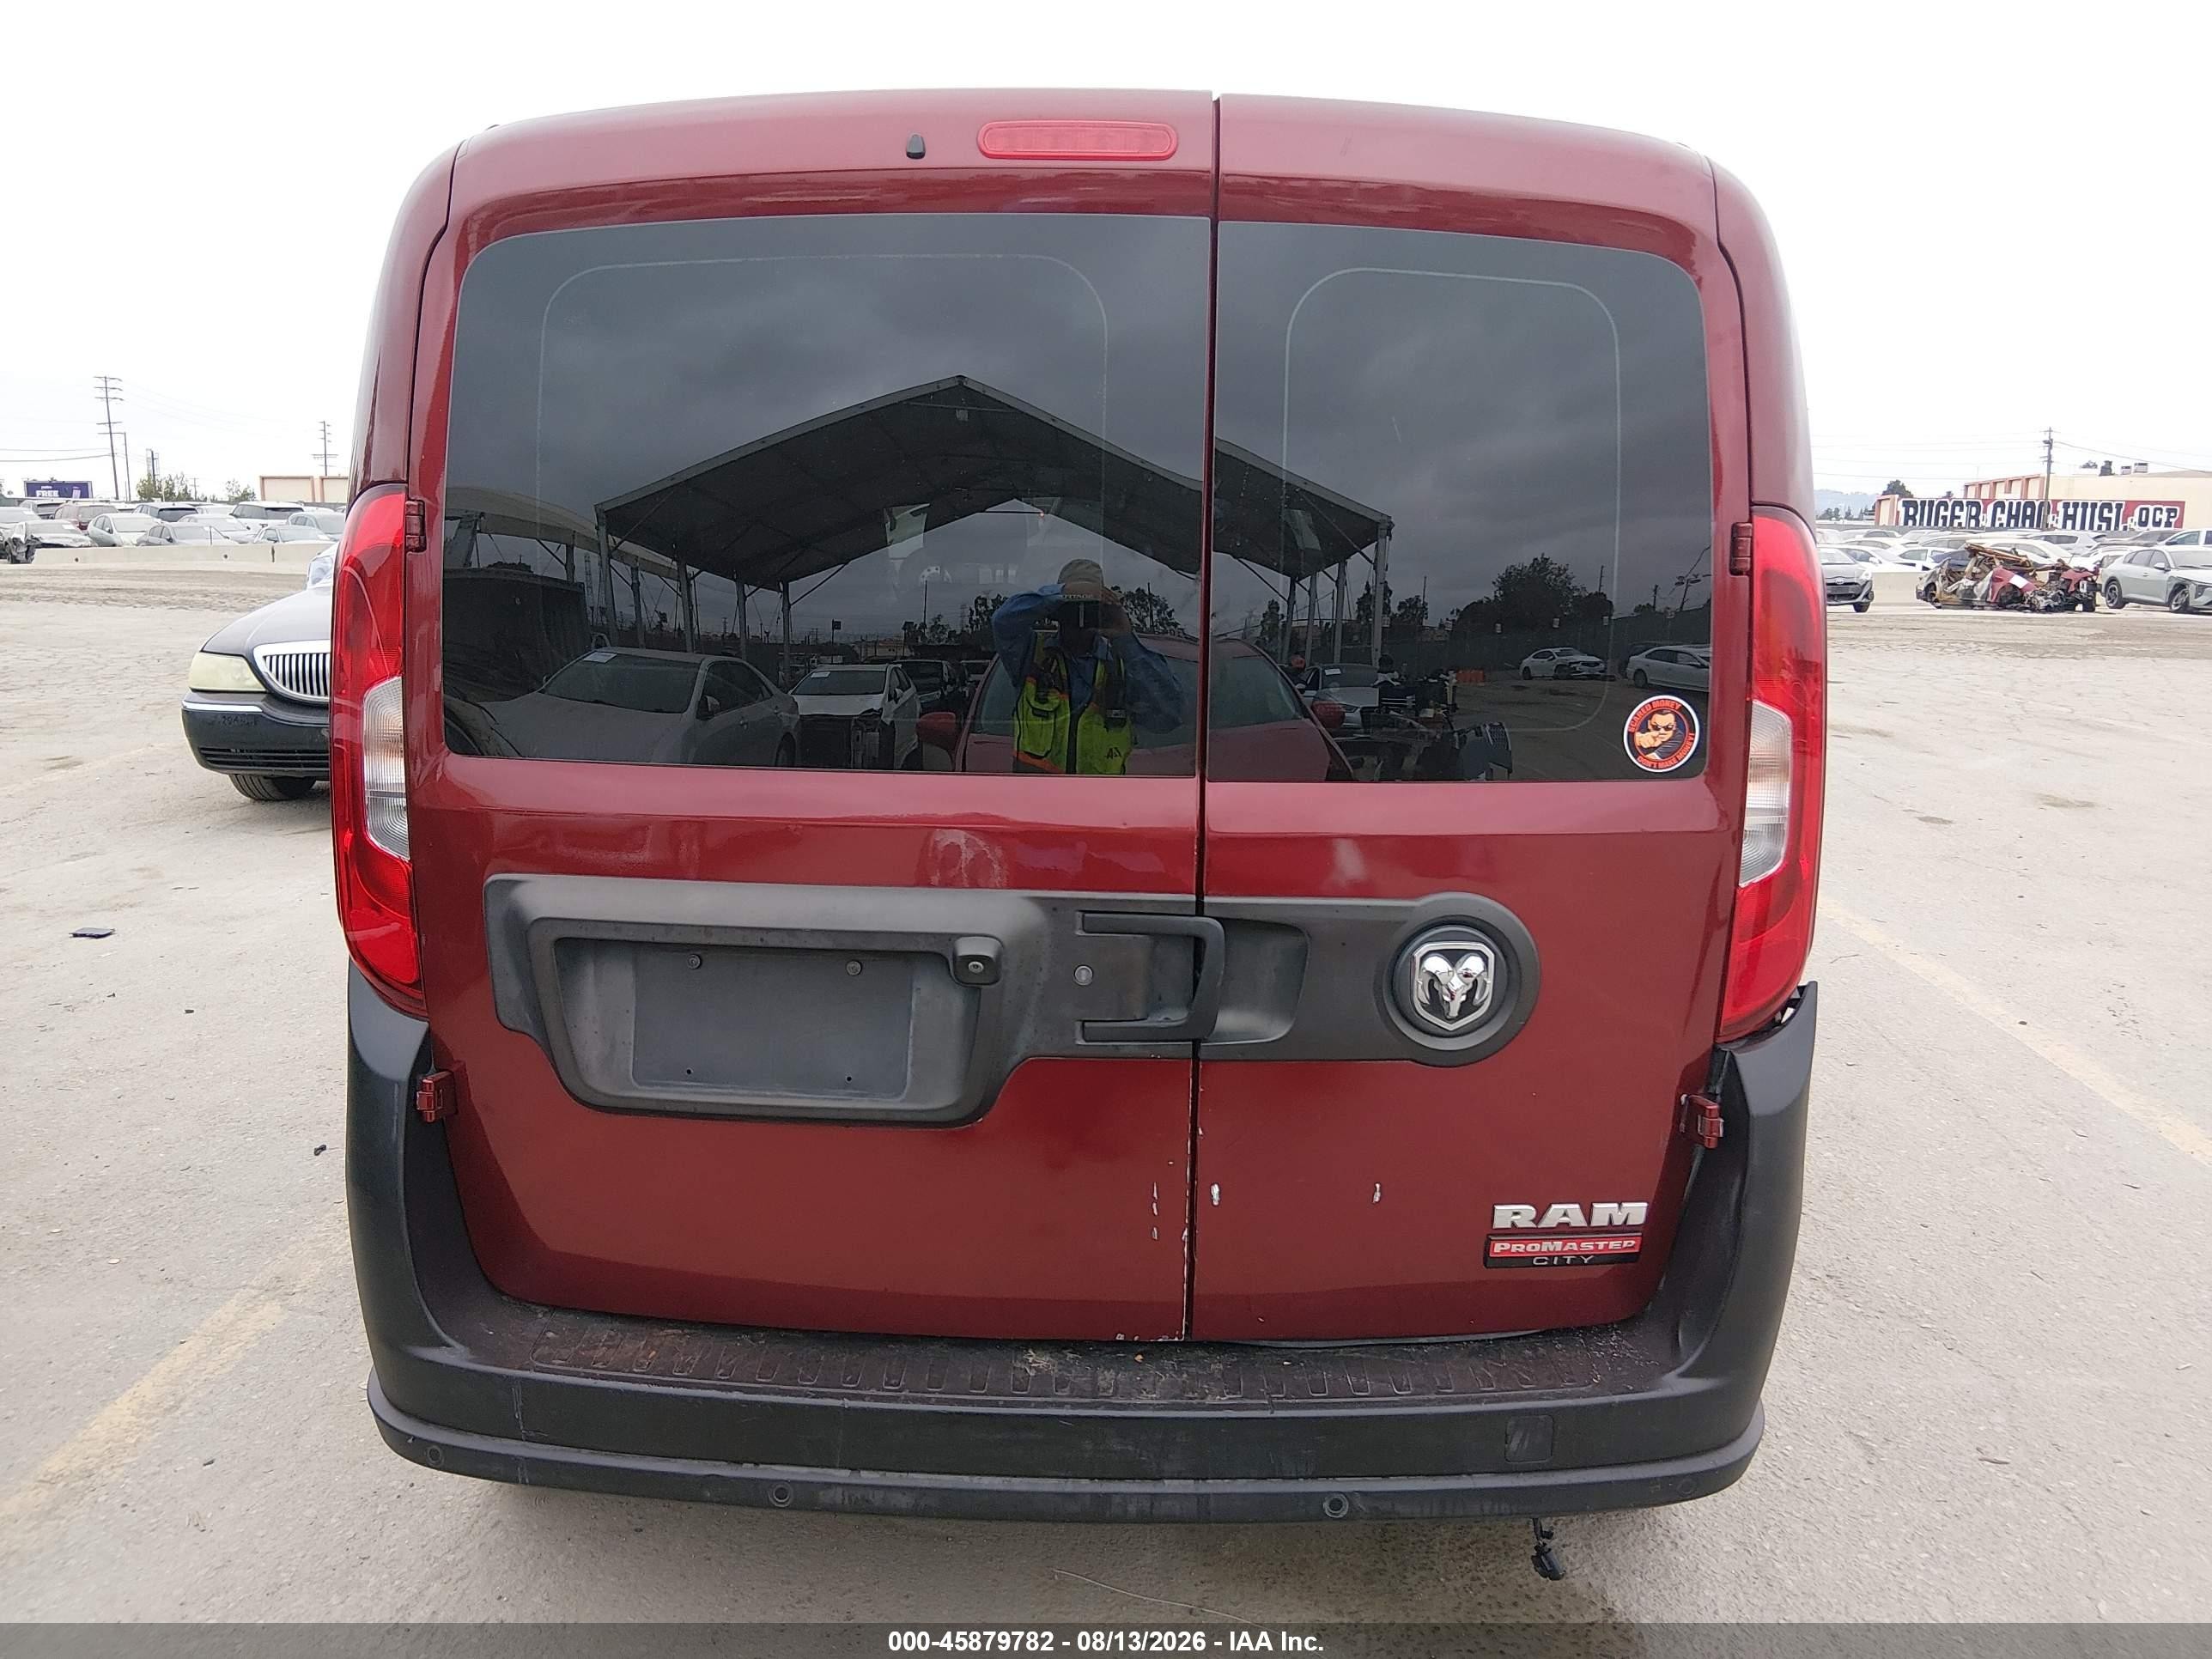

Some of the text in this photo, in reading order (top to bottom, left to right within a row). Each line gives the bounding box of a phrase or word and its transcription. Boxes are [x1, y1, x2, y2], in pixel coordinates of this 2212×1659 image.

[2138, 507, 2179, 528] OCP
[1652, 700, 1680, 709] MONEY
[1657, 759, 1678, 768] MAKE
[1492, 1201, 1649, 1230] RAM
[1532, 1255, 1595, 1266] CITY
